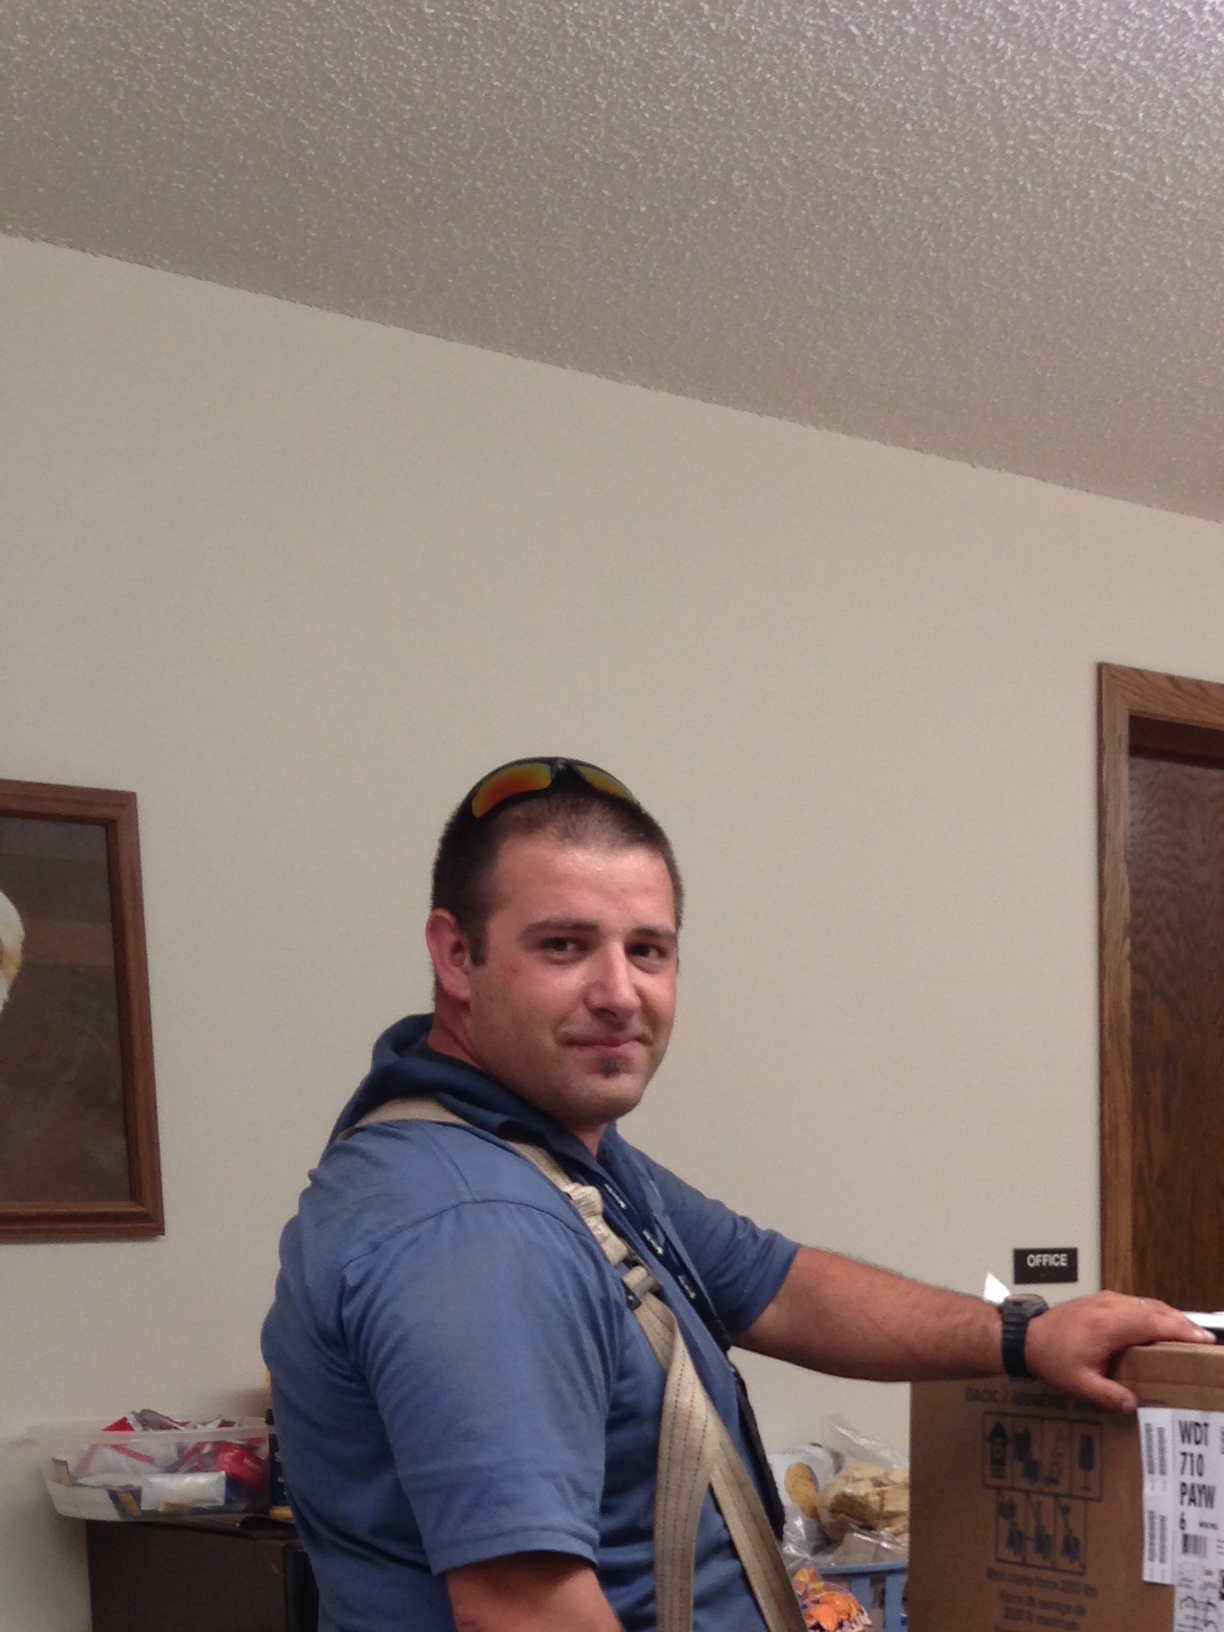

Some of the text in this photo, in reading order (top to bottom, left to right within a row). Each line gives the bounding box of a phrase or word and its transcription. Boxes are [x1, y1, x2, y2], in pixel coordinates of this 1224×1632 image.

[1026, 1253, 1068, 1268] OFFICE
[1178, 1419, 1210, 1447] WDT
[1179, 1451, 1205, 1477] 710
[1179, 1481, 1215, 1510] PAYW
[1179, 1512, 1187, 1532] 6
